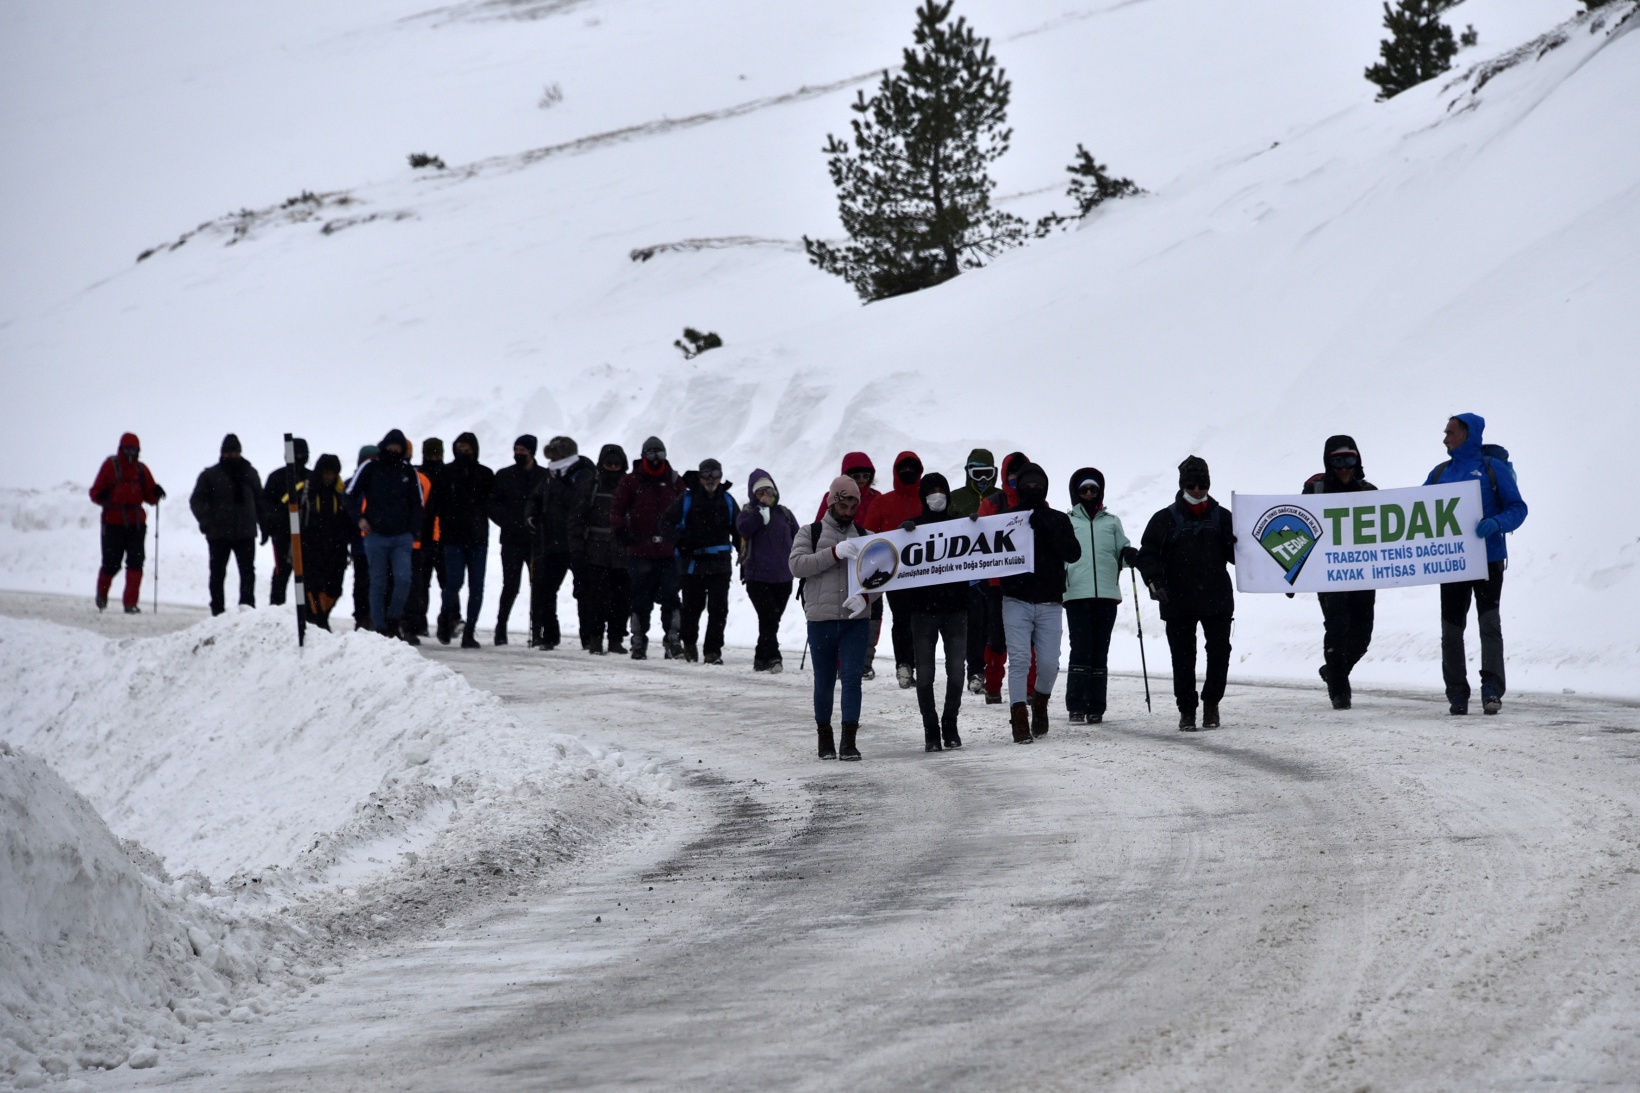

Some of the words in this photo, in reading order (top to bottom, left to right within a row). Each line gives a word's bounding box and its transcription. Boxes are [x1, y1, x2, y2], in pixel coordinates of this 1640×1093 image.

[1324, 497, 1462, 546] TEDAK
[901, 529, 1016, 567] GÜDAK
[1271, 535, 1309, 561] TEDAK
[1325, 550, 1378, 564] TRABZON
[1380, 547, 1413, 561] TENİS
[1416, 541, 1465, 558] DAĞCILIK
[931, 562, 955, 574] Dağcılık
[955, 563, 963, 571] ve
[963, 560, 978, 571] Doğa
[979, 559, 1004, 569] Sporları
[1004, 555, 1026, 566] Kulübü
[1327, 567, 1364, 582] KAYAK
[1372, 563, 1416, 580] İHTİSAS
[1423, 558, 1466, 575] KULÜBÜ
